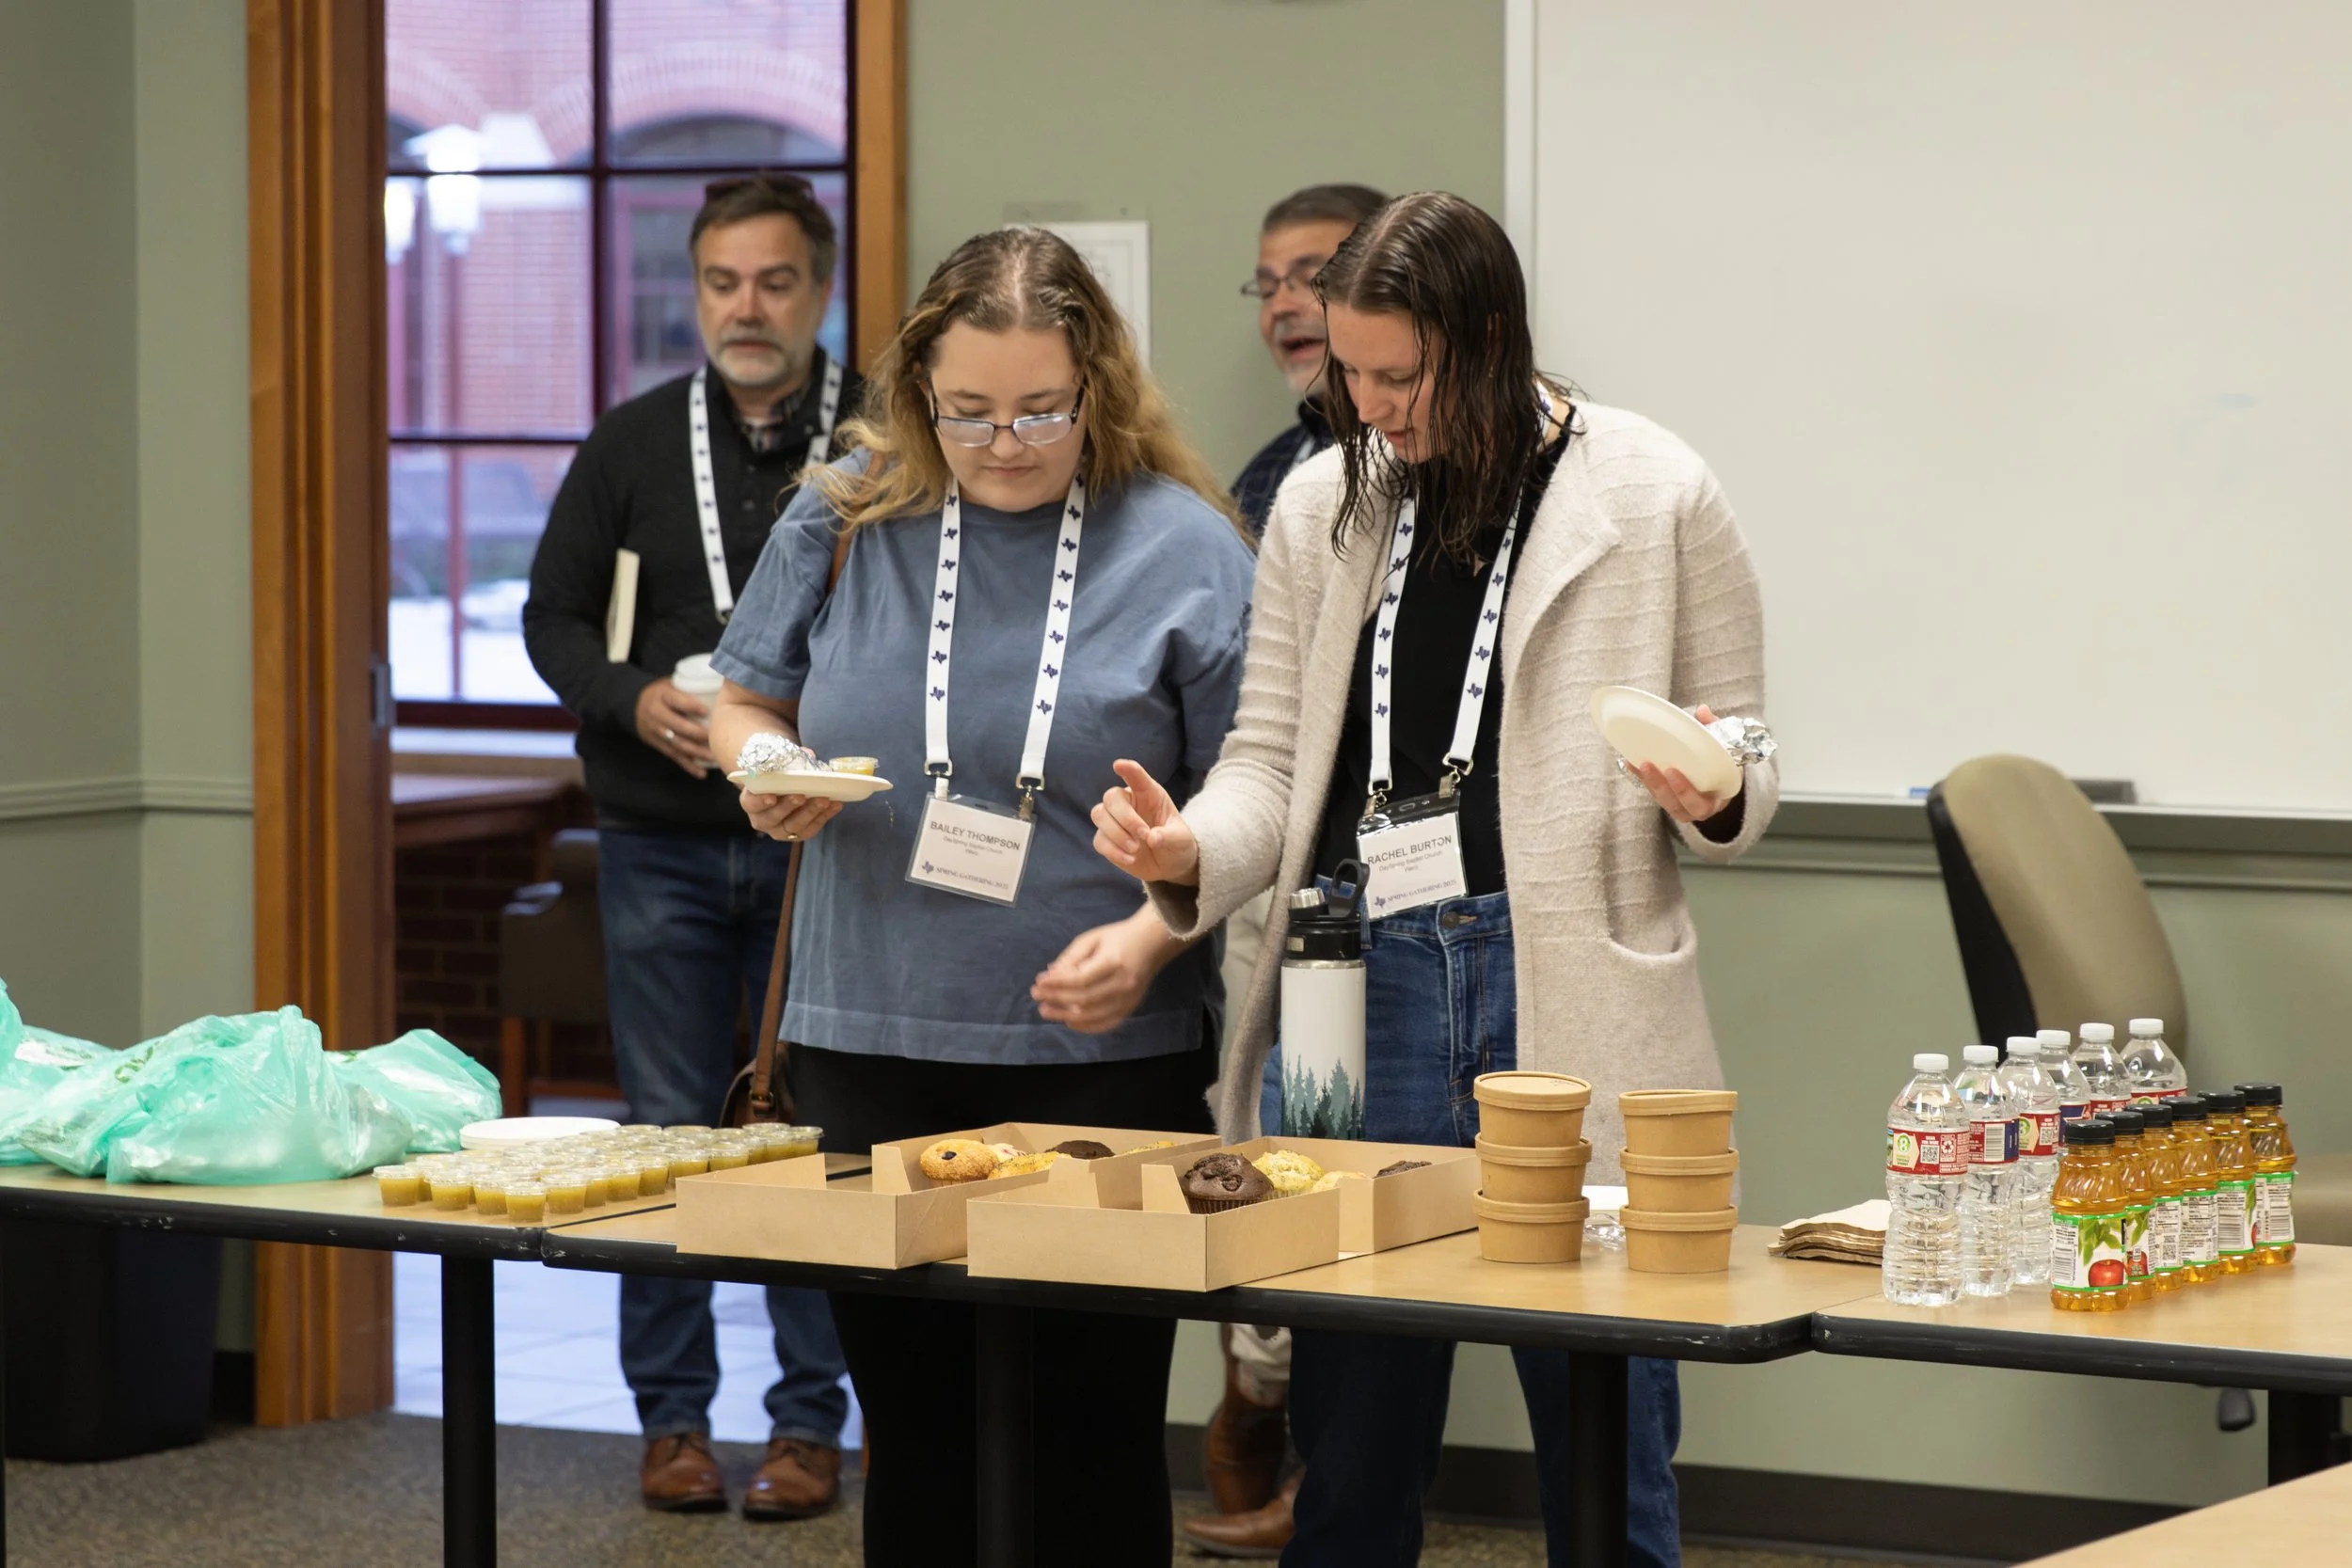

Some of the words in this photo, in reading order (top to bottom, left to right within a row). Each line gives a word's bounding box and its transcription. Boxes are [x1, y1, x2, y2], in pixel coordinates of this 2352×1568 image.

[930, 821, 965, 836] BAILEY
[967, 831, 1021, 850] THOMPSON
[1367, 848, 1407, 864] RACHEL
[1410, 835, 1452, 854] BURTON
[1387, 893, 1407, 902] SPRING
[1408, 883, 1443, 896] GATHERING
